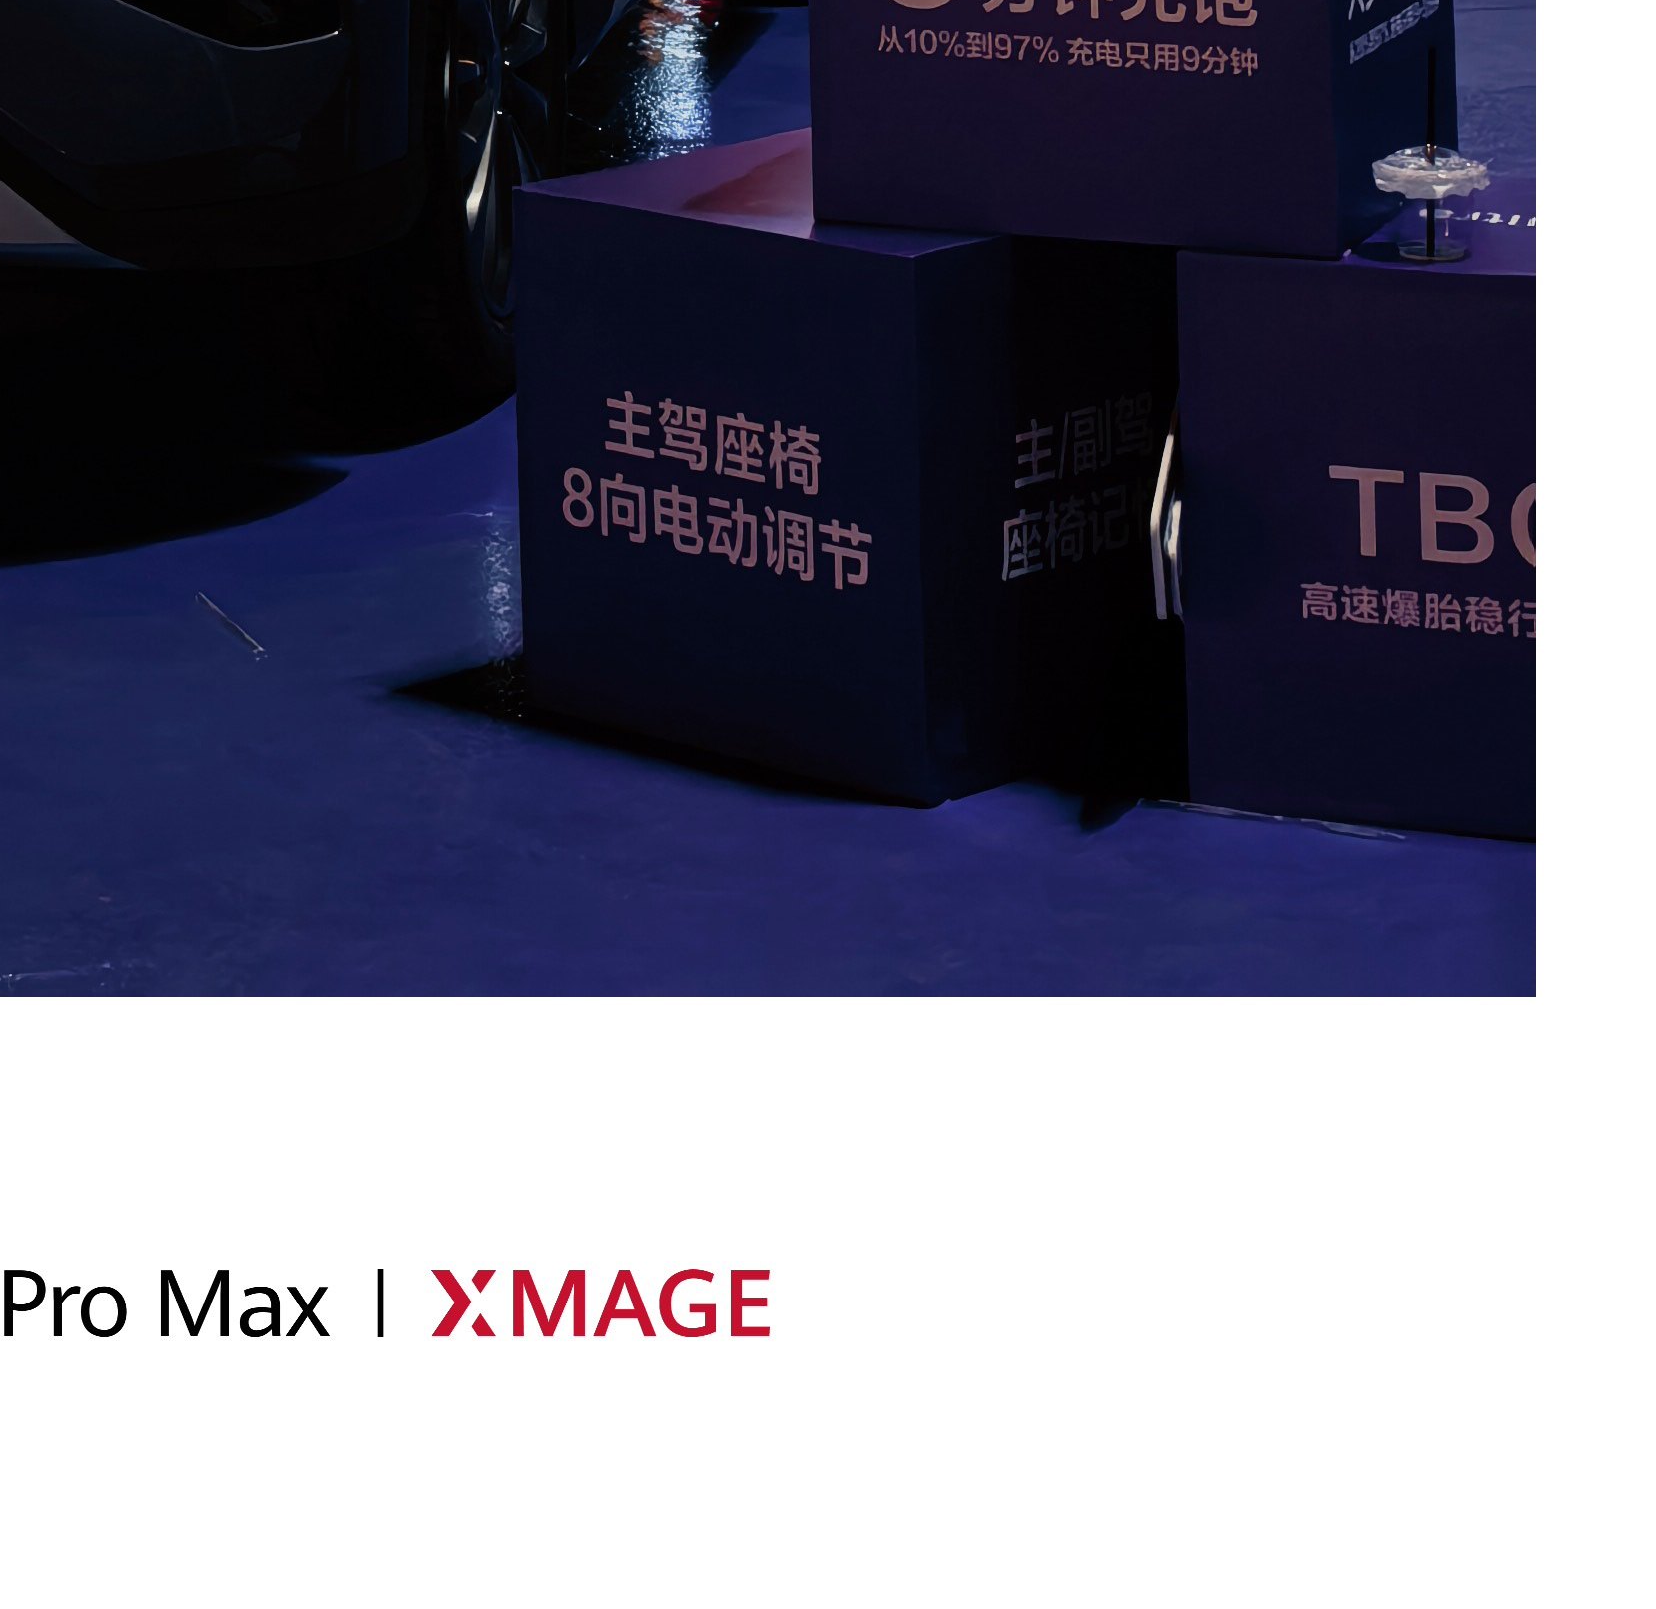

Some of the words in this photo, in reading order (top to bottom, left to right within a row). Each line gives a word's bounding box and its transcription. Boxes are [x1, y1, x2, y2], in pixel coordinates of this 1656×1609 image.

[878, 24, 1060, 64] 从10%到97%
[1065, 37, 1259, 77] 充电只用9分钟
[605, 390, 822, 495] 主驾座椅
[562, 467, 873, 590] 8向电动调节
[1000, 481, 1150, 582] 座椅记
